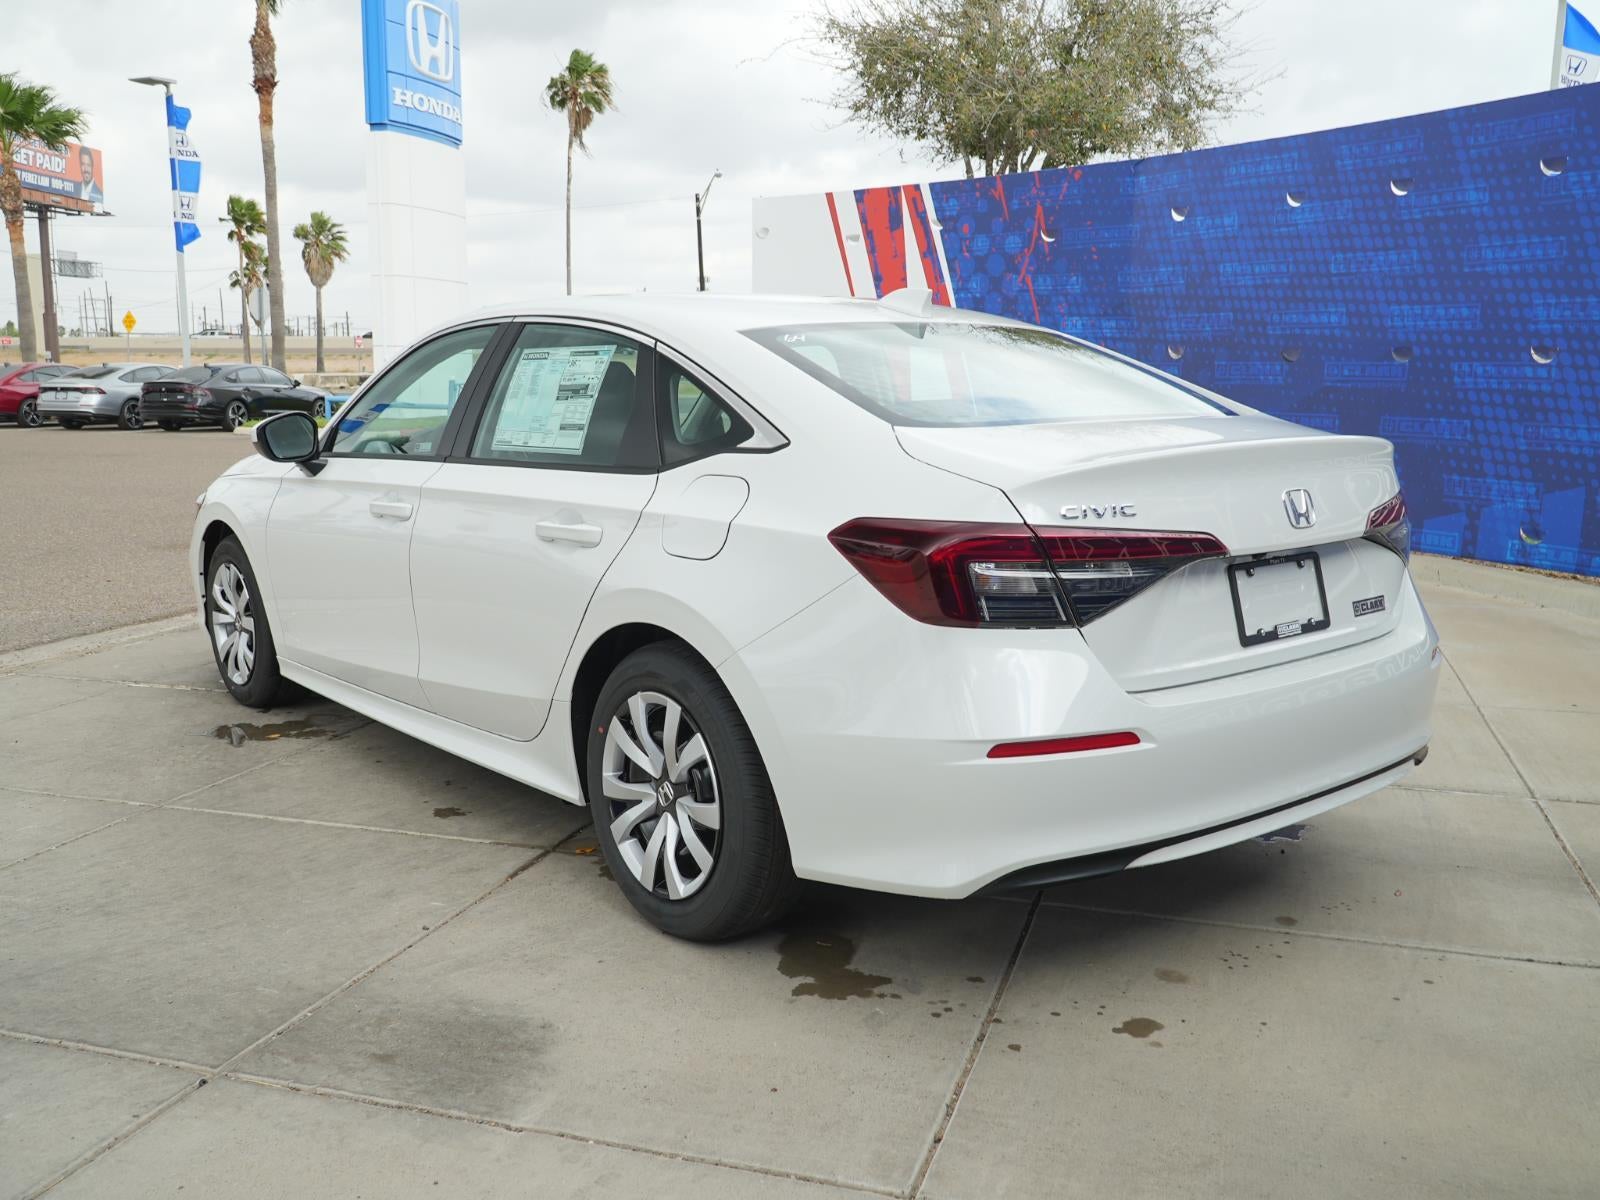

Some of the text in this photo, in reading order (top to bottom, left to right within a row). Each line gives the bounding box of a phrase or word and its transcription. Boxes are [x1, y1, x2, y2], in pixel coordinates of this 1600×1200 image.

[392, 86, 462, 125] HONDA
[13, 147, 35, 166] GET
[36, 152, 66, 174] PAID!
[1060, 503, 1137, 520] CIVIC
[1360, 598, 1385, 612] CLARK
